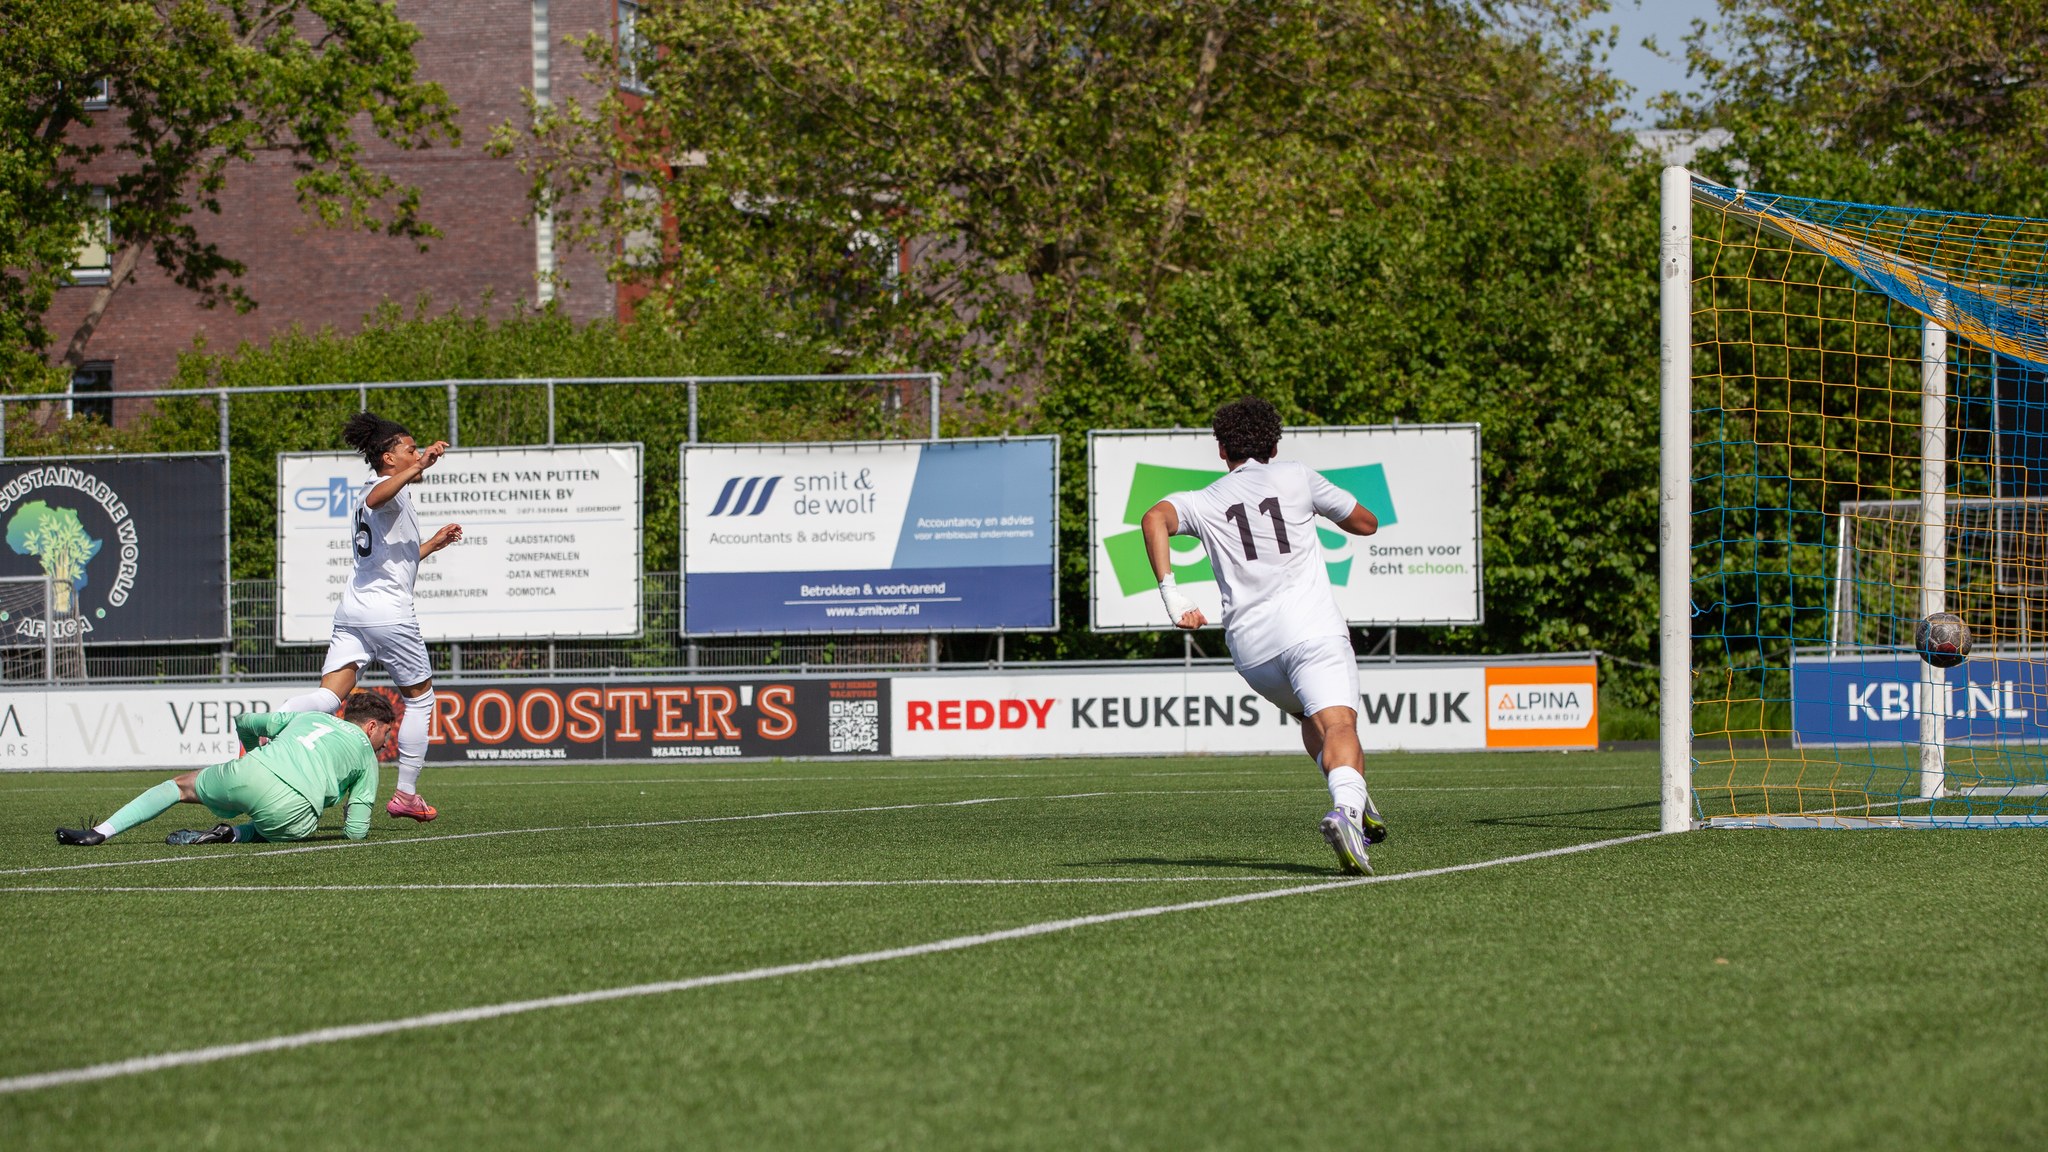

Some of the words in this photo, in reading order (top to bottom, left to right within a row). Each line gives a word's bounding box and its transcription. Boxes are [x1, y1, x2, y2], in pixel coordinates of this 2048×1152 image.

[421, 472, 487, 485] MBERGEN
[492, 472, 509, 483] EN
[515, 470, 541, 482] VAN
[547, 469, 600, 481] PUTTEN
[794, 471, 848, 492] smit
[854, 467, 873, 490] &
[420, 490, 550, 504] ELEKTROTECHNIEK
[556, 488, 575, 499] BV
[794, 494, 820, 515] de
[825, 492, 876, 514] wolf
[917, 517, 982, 528] Accountancy
[984, 516, 998, 526] en
[1000, 515, 1034, 526] advies
[1225, 497, 1291, 561] 11
[0, 466, 128, 523] SUSTAINABLE
[109, 519, 139, 607] WORLD
[709, 532, 793, 545] Accountants
[797, 531, 807, 543] &
[811, 529, 876, 543] adviseurs
[980, 530, 1034, 538] ondernemers
[1369, 545, 1423, 556] Samen
[1427, 545, 1462, 556] voor
[534, 569, 589, 578] NETWERKEN
[1369, 561, 1404, 575] écht
[1407, 562, 1468, 575] schoon.
[801, 584, 860, 597] Betrokken
[863, 583, 874, 595] &
[876, 582, 946, 595] voortvarend
[826, 603, 920, 617] www.smitwolf.nl
[1498, 692, 1580, 710] ALPINA
[1848, 680, 2028, 722] KB.NL
[167, 699, 272, 735] VER
[429, 684, 798, 745] ROOSTER'S
[907, 698, 1056, 731] REDDY
[1072, 695, 1260, 729] KEUKENS
[296, 722, 335, 750] 1
[466, 748, 567, 759] WWW.ROOSTERS.NL
[651, 747, 703, 757] MAALTIJD
[713, 746, 742, 755] GRILL
